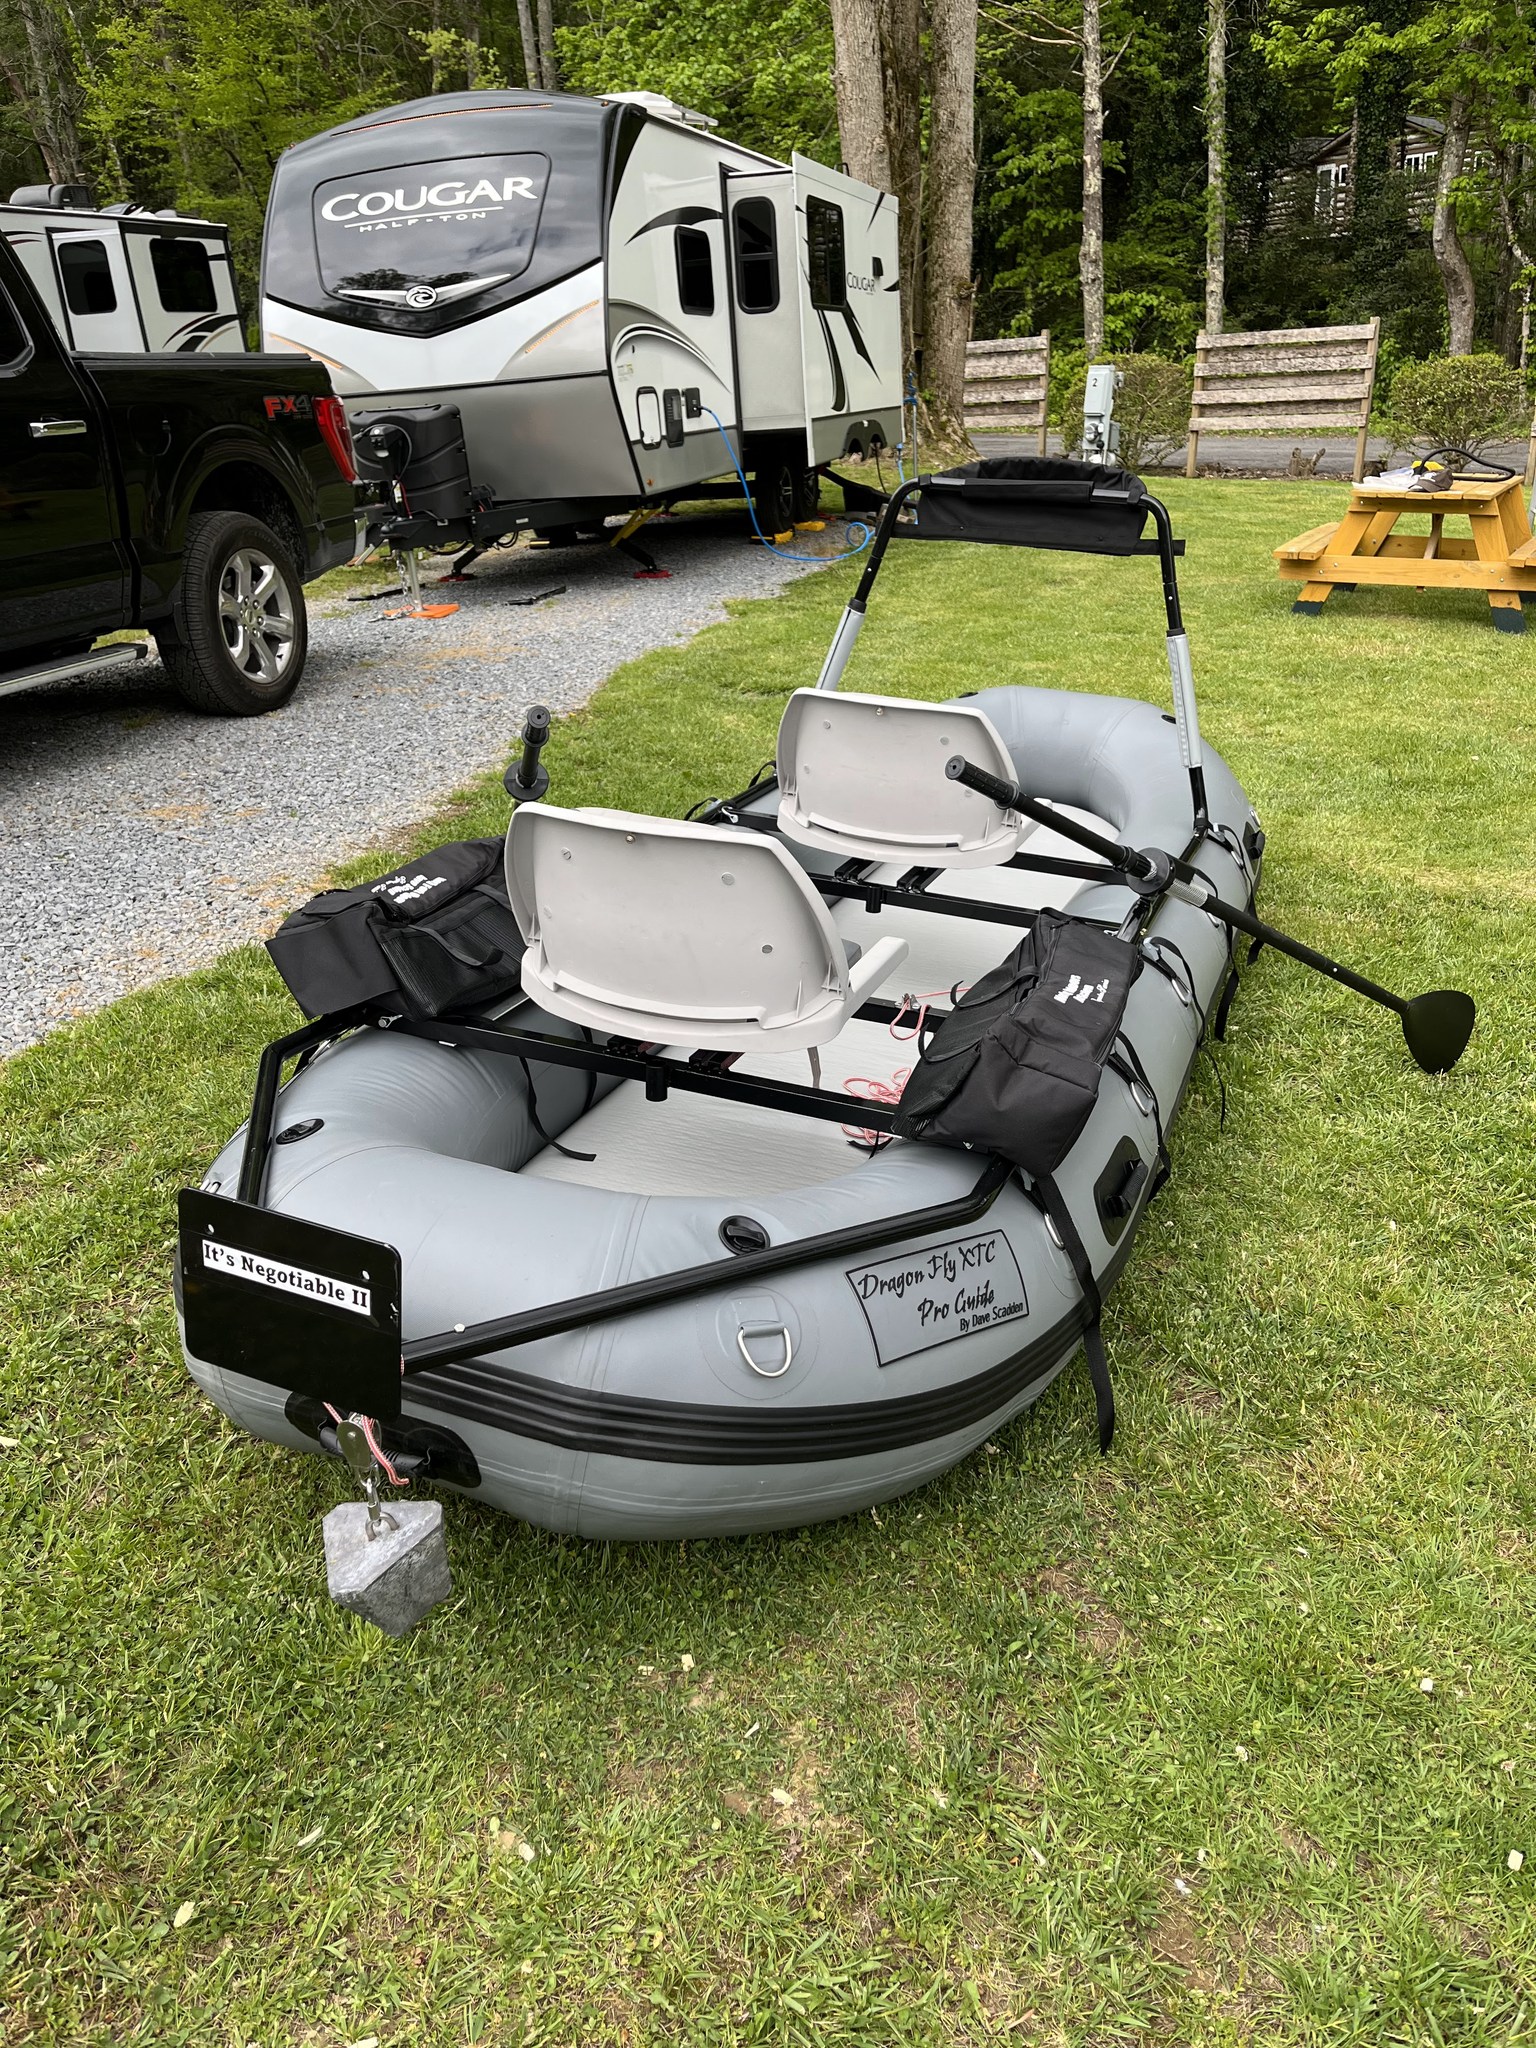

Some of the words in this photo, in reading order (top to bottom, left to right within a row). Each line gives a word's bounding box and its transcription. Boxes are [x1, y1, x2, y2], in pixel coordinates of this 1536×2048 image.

[321, 177, 538, 221] COUGAR
[1092, 377, 1098, 387] 2
[263, 395, 311, 420] FX4
[241, 1255, 346, 1301] Negotiable
[352, 1289, 368, 1308] II
[857, 1270, 925, 1300] Dragon
[927, 1250, 957, 1283] Fly
[958, 1239, 996, 1271] XTC
[917, 1298, 950, 1327] Pro
[954, 1279, 995, 1315] Guide
[959, 1318, 971, 1333] By
[972, 1314, 991, 1328] Dave
[992, 1301, 1024, 1321] Scadden
